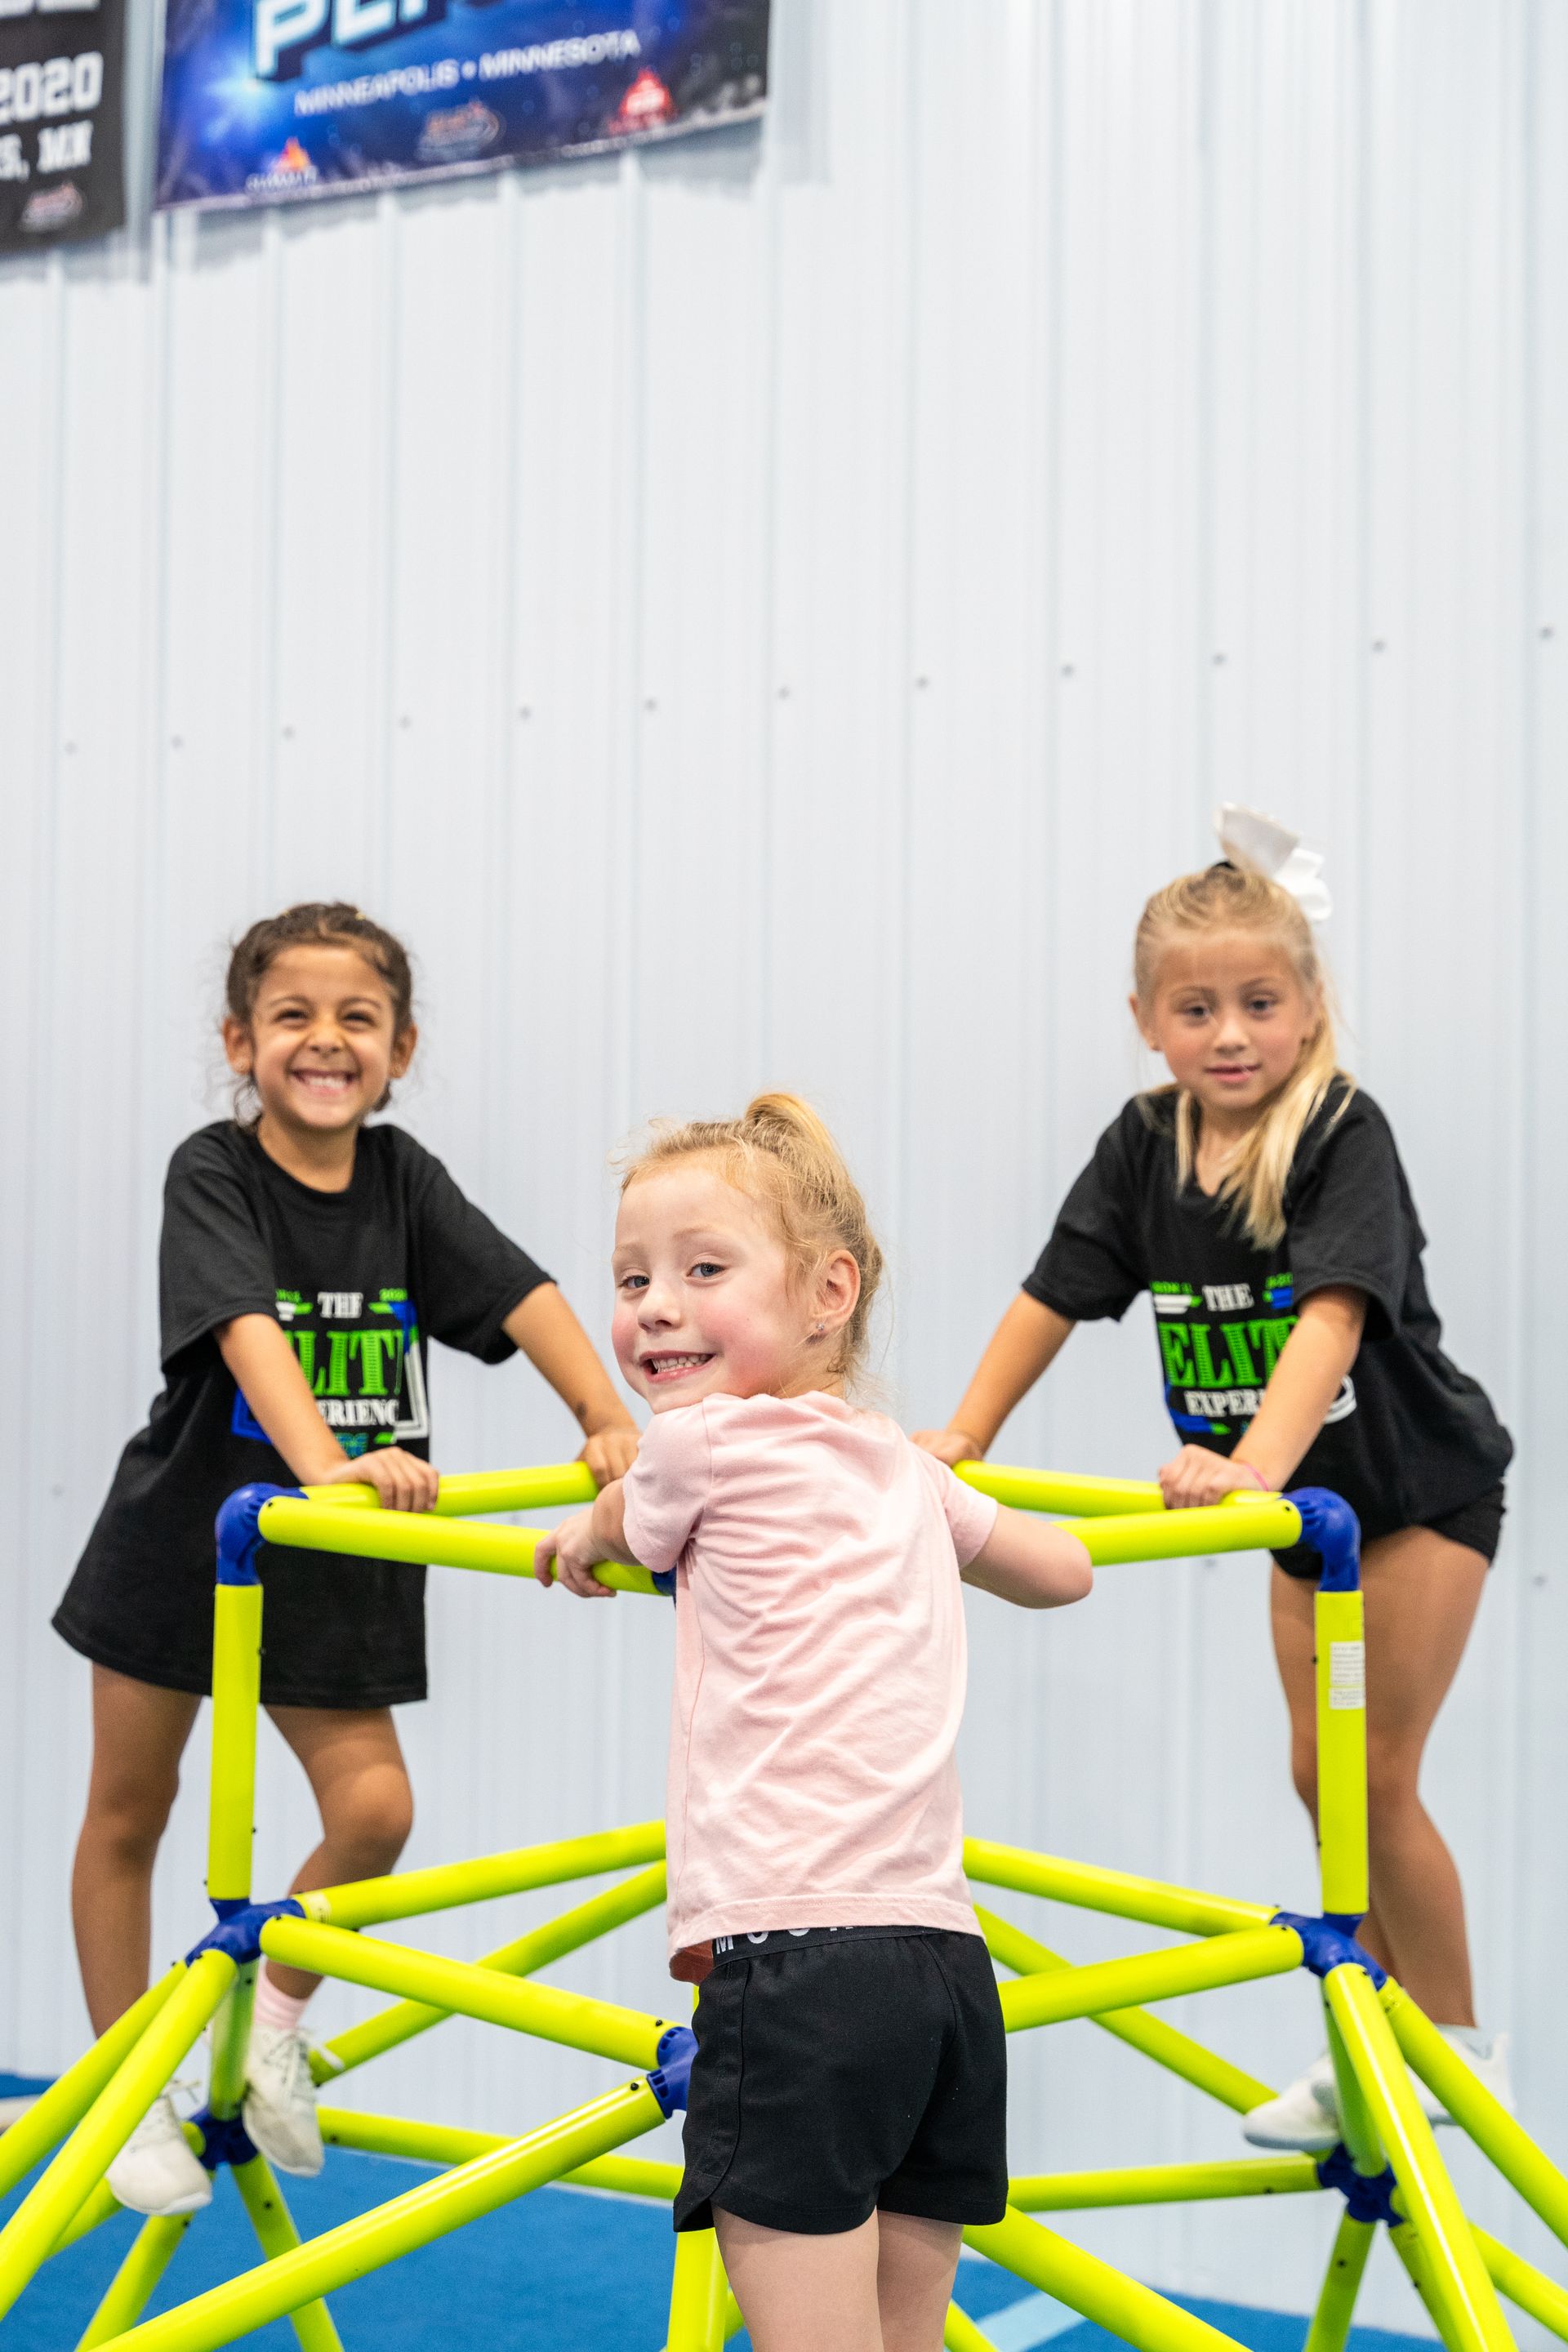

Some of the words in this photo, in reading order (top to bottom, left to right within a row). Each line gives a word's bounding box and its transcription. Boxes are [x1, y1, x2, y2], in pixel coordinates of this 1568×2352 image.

[295, 58, 460, 116] MINNEAPOLIS
[479, 29, 641, 81] MINNESOTA
[1202, 1283, 1255, 1312] THE
[283, 1329, 404, 1397] LIT
